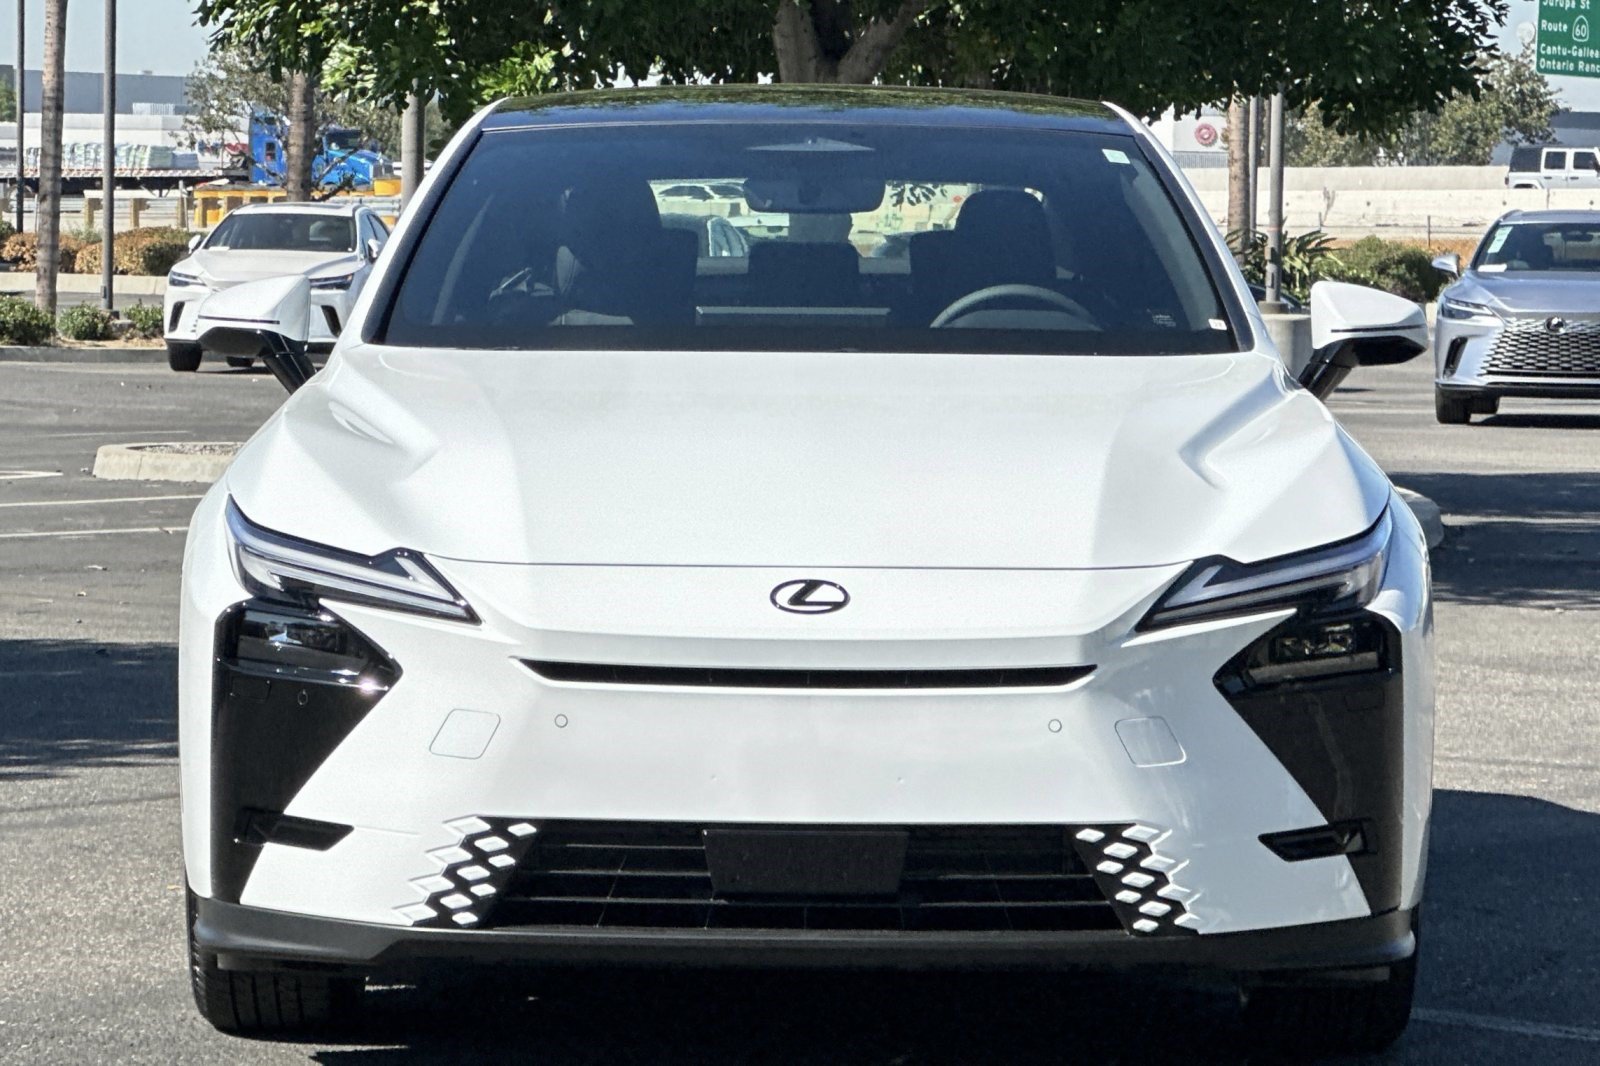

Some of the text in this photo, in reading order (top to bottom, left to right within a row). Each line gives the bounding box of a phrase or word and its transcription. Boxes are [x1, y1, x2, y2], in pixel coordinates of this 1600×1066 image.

[1580, 0, 1590, 9] St
[1541, 19, 1587, 37] Route 60
[1539, 58, 1574, 71] Ontario
